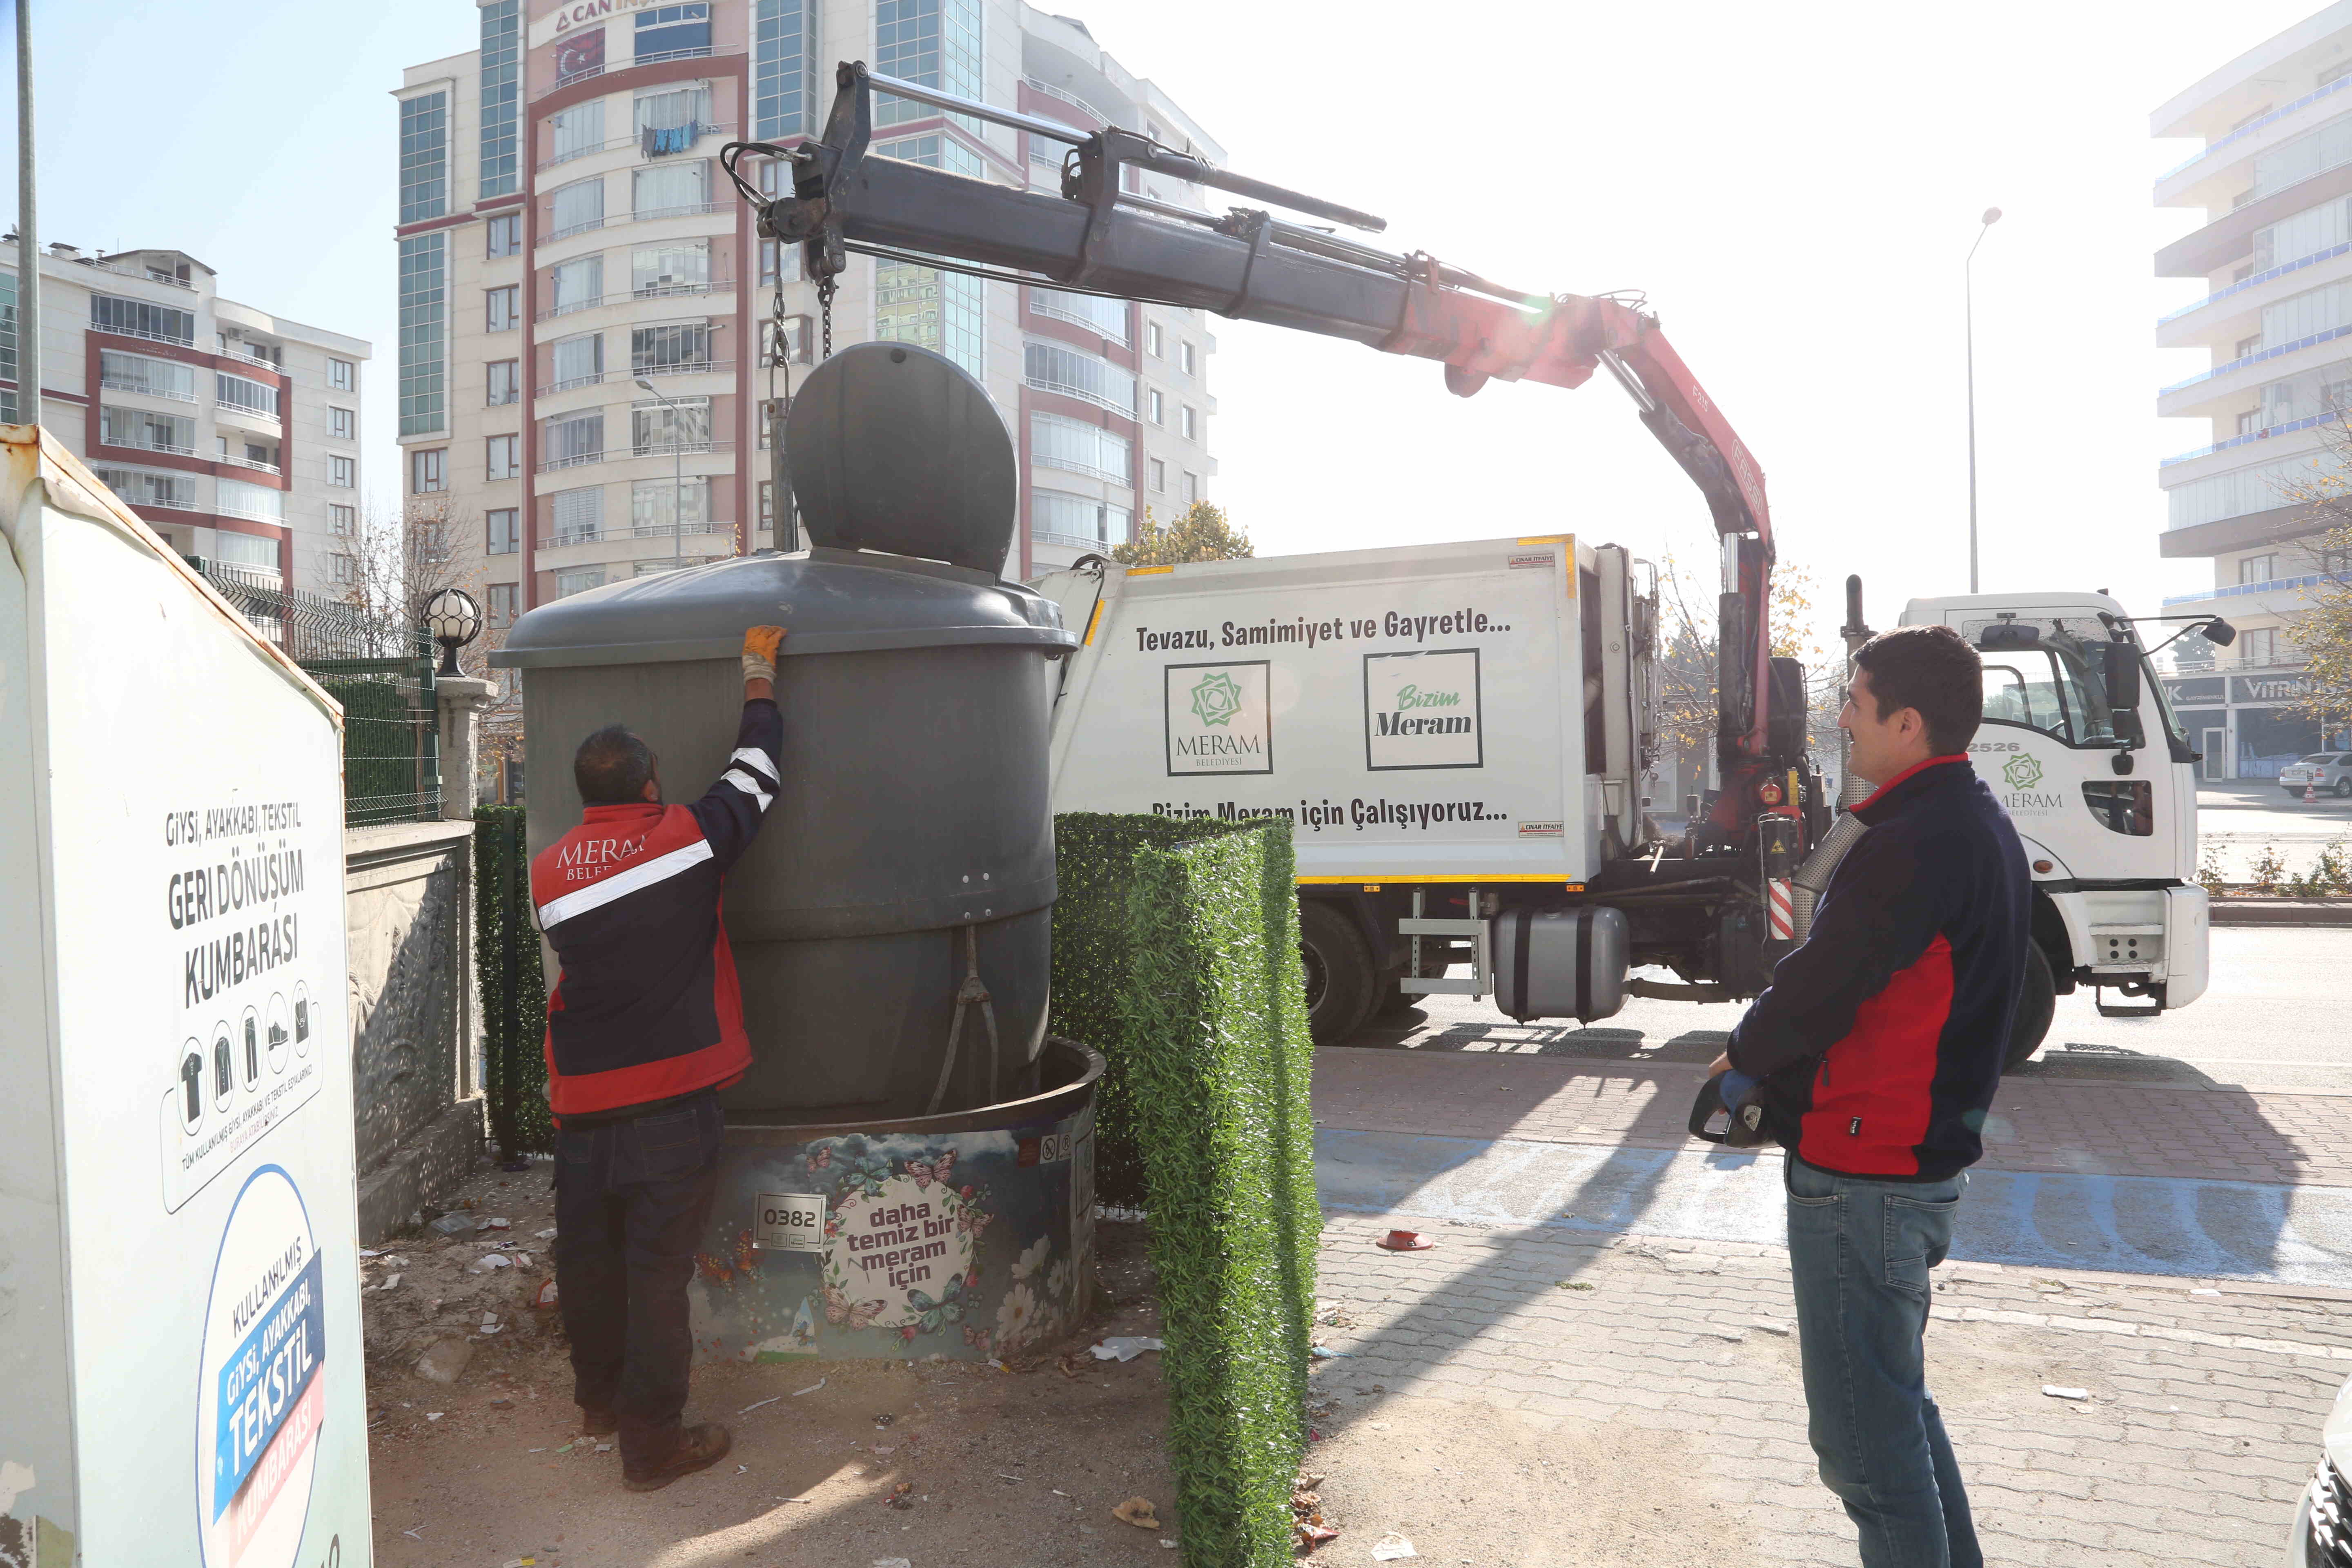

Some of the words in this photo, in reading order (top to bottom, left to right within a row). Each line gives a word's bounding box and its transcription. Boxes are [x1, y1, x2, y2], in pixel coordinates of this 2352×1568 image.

[1734, 446, 1761, 511] FASSI
[1136, 627, 1215, 651] Tevazu,
[1222, 617, 1343, 648] Samimiyet
[1350, 619, 1376, 638] ve
[1384, 608, 1511, 643] Gayretle...
[1396, 684, 1461, 710] Bizim
[1374, 712, 1472, 736] Meram
[1176, 733, 1262, 756] MERAM
[1967, 742, 2020, 752] 2526
[1196, 757, 1243, 767] BELEDİYESİ
[262, 802, 301, 832] TEKSTİL
[1301, 799, 1344, 832] için
[1351, 798, 1507, 831] Çalışıyoruz...
[555, 835, 645, 869] MERA
[217, 838, 304, 915] DÖNÜŞÜM
[185, 912, 297, 1009] KUMBARASI
[182, 1152, 194, 1172] TÜM
[195, 1125, 228, 1162] KULLANILMIŞ
[243, 1098, 264, 1125] AYAKKABI
[264, 1094, 270, 1107] VE
[271, 1080, 287, 1102] TEKSTİL
[288, 1064, 312, 1092] EŞYALARINIZI
[764, 1208, 816, 1227] 0382
[869, 1202, 931, 1227] daha
[847, 1223, 919, 1252] temiz
[924, 1214, 955, 1238] bir
[862, 1240, 947, 1271] meram
[232, 1236, 301, 1339] KULLANILMIŞ
[889, 1263, 931, 1291] için
[229, 1319, 312, 1477] TEKSTİL
[237, 1394, 312, 1544] KUMBARASI
